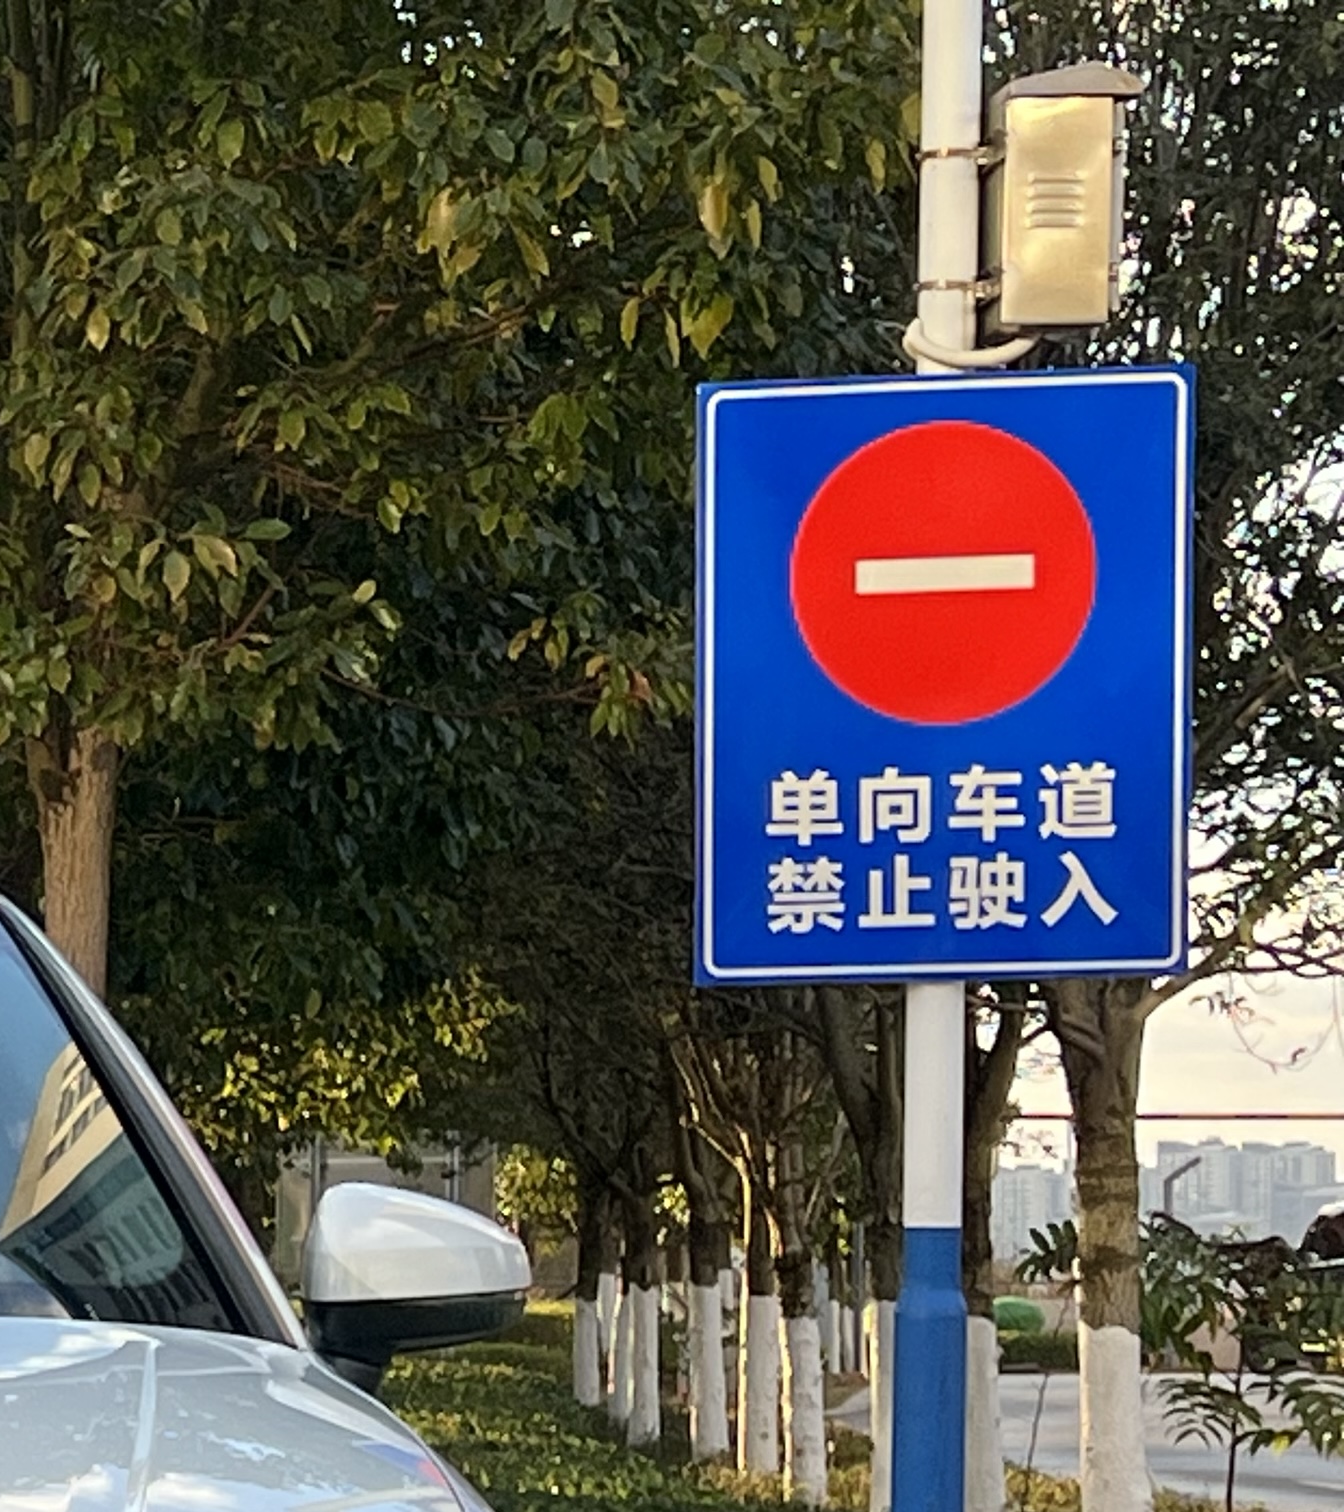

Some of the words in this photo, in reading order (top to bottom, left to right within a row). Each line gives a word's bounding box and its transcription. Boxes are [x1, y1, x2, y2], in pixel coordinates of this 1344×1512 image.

[765, 761, 1117, 846] 单向车道
[766, 851, 1119, 934] 禁止驶入
